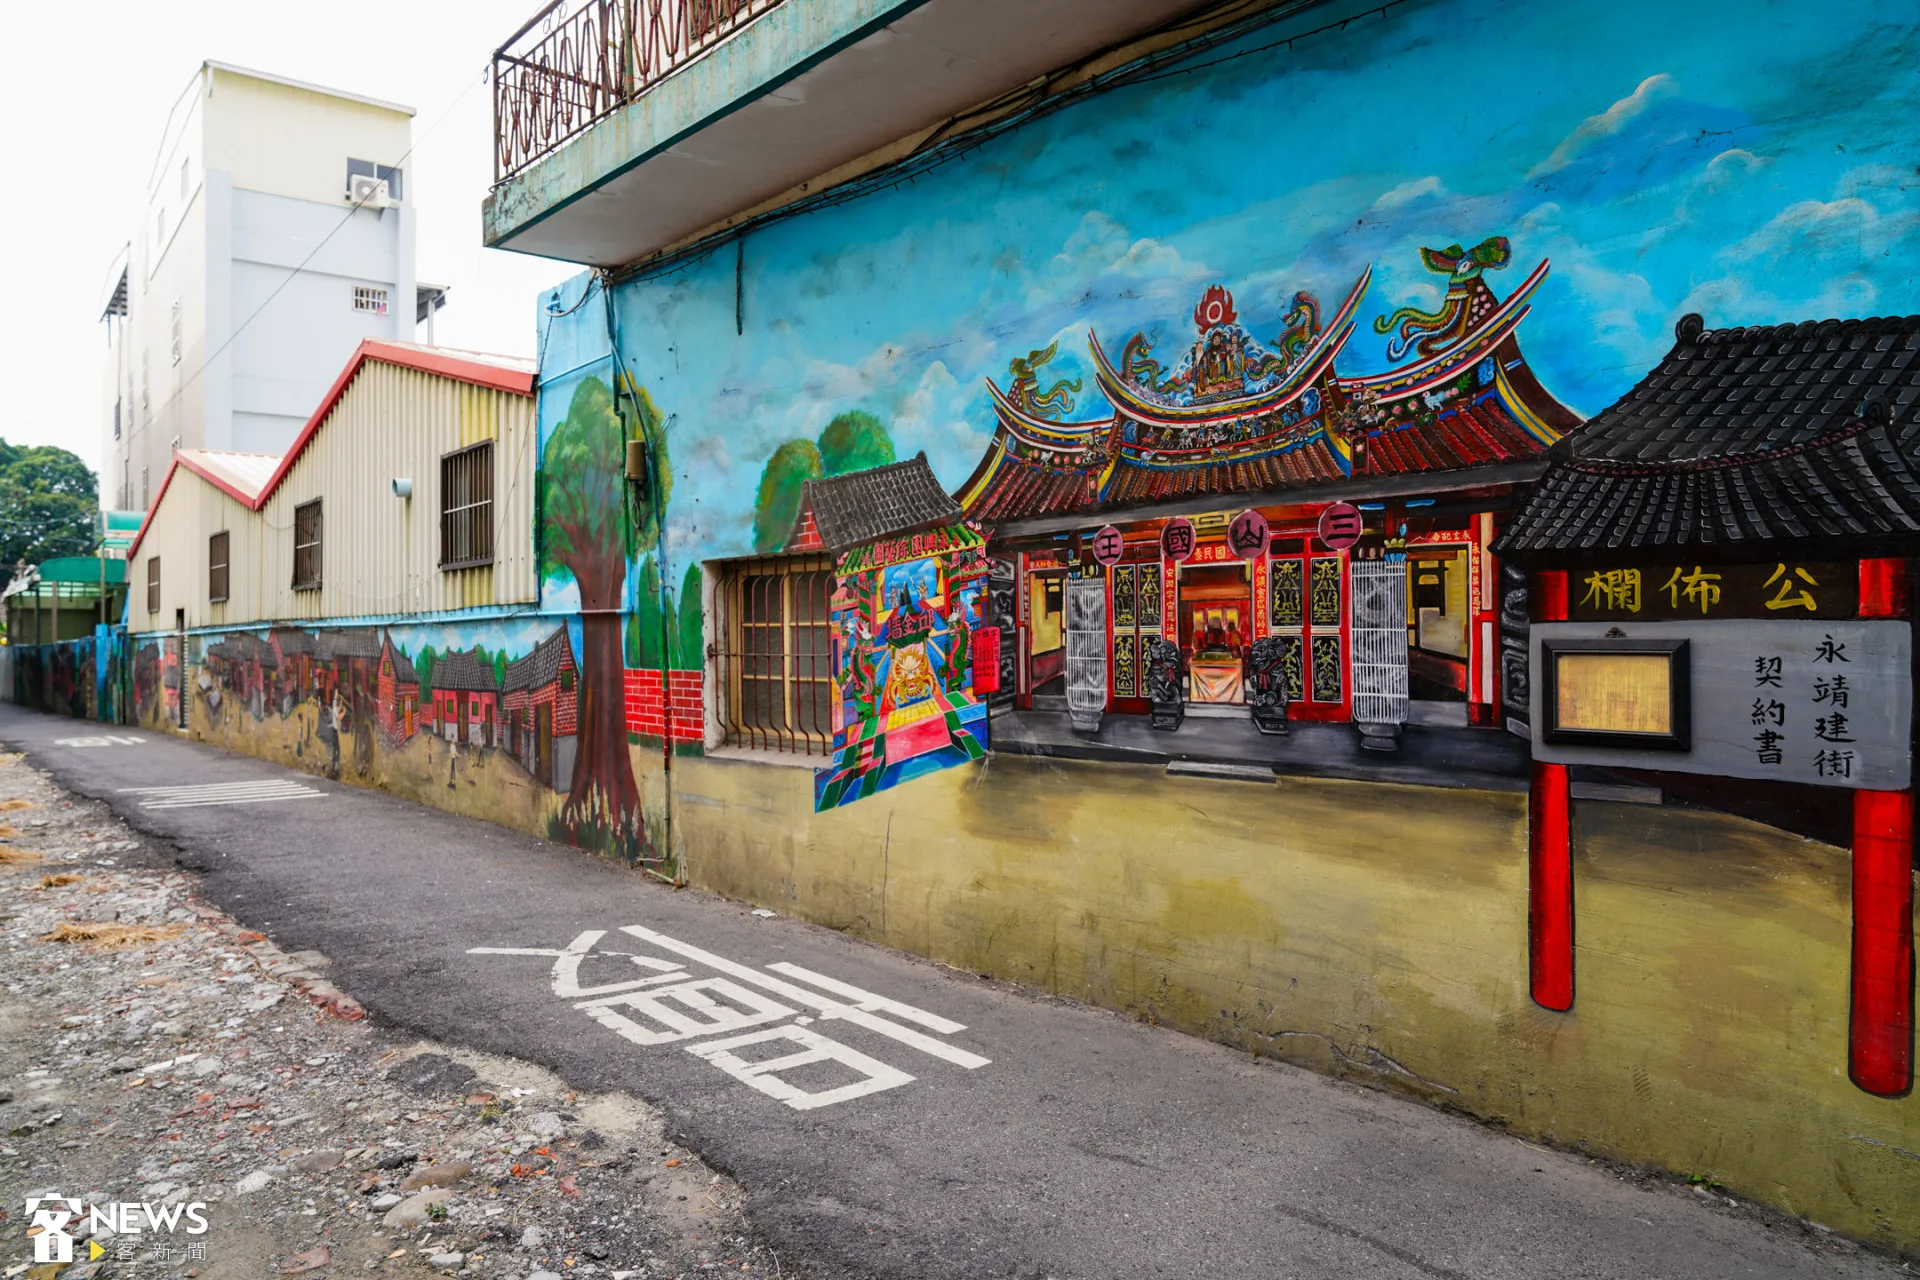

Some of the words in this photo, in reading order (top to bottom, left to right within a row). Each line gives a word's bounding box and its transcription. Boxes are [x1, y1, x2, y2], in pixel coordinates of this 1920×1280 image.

[1579, 563, 1820, 614] 公佈欄
[1751, 655, 1786, 766] 契約書
[1811, 634, 1858, 779] 永靖建街
